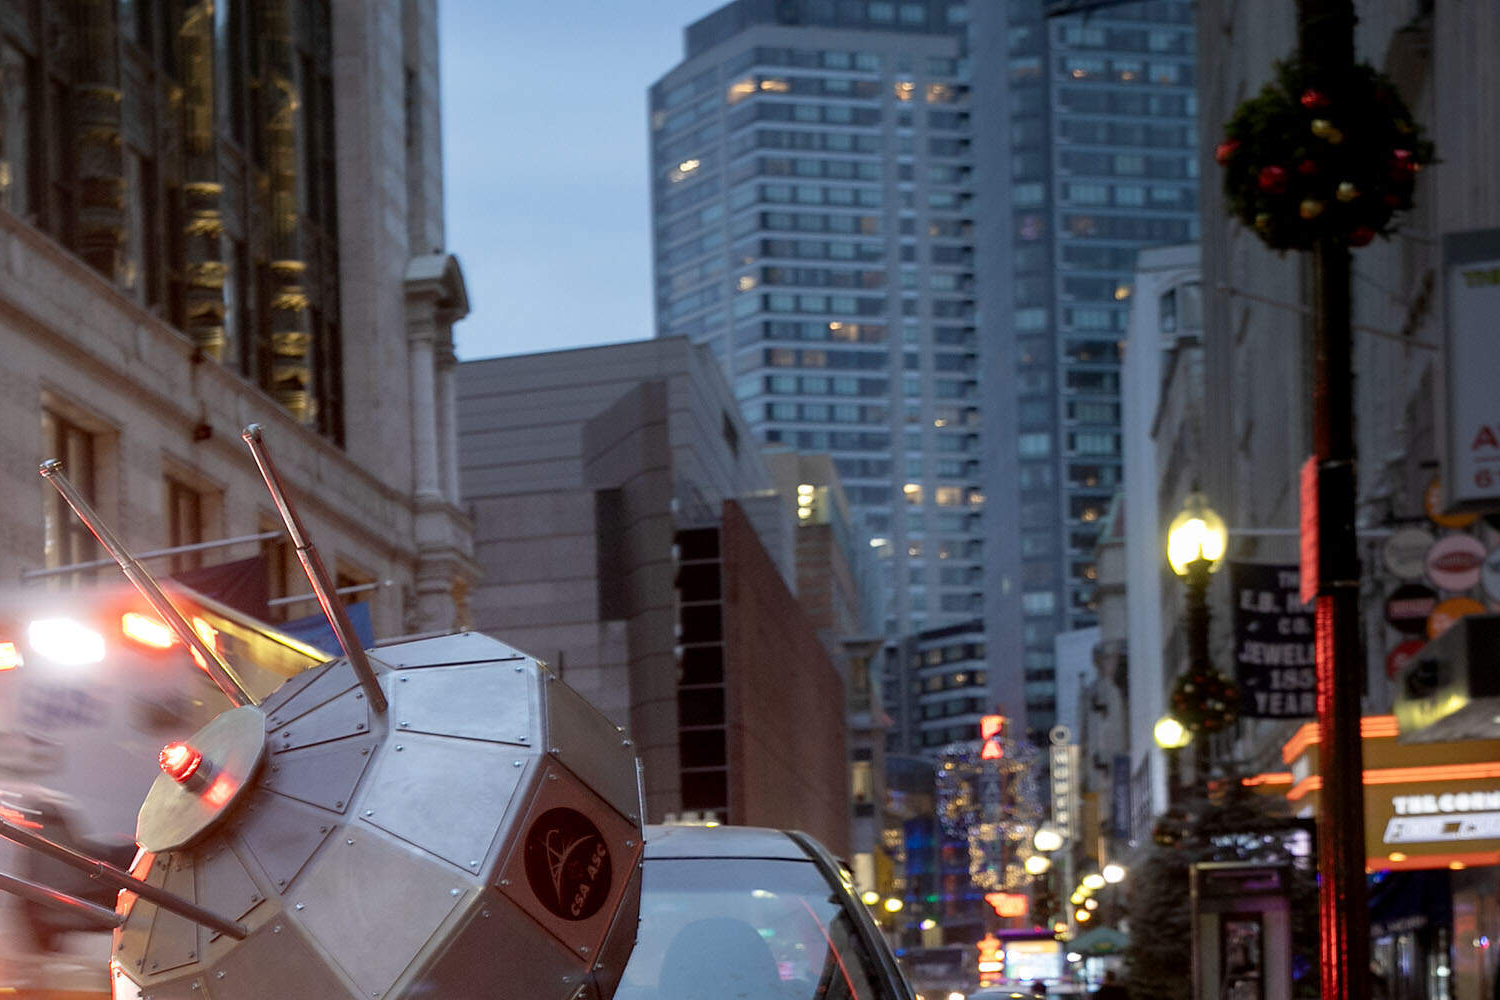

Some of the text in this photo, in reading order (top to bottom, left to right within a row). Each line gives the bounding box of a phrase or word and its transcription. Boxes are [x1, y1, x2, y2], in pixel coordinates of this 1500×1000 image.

[1470, 424, 1500, 452] A
[1255, 692, 1316, 715] YEAR
[570, 843, 606, 917] CSA ASC
